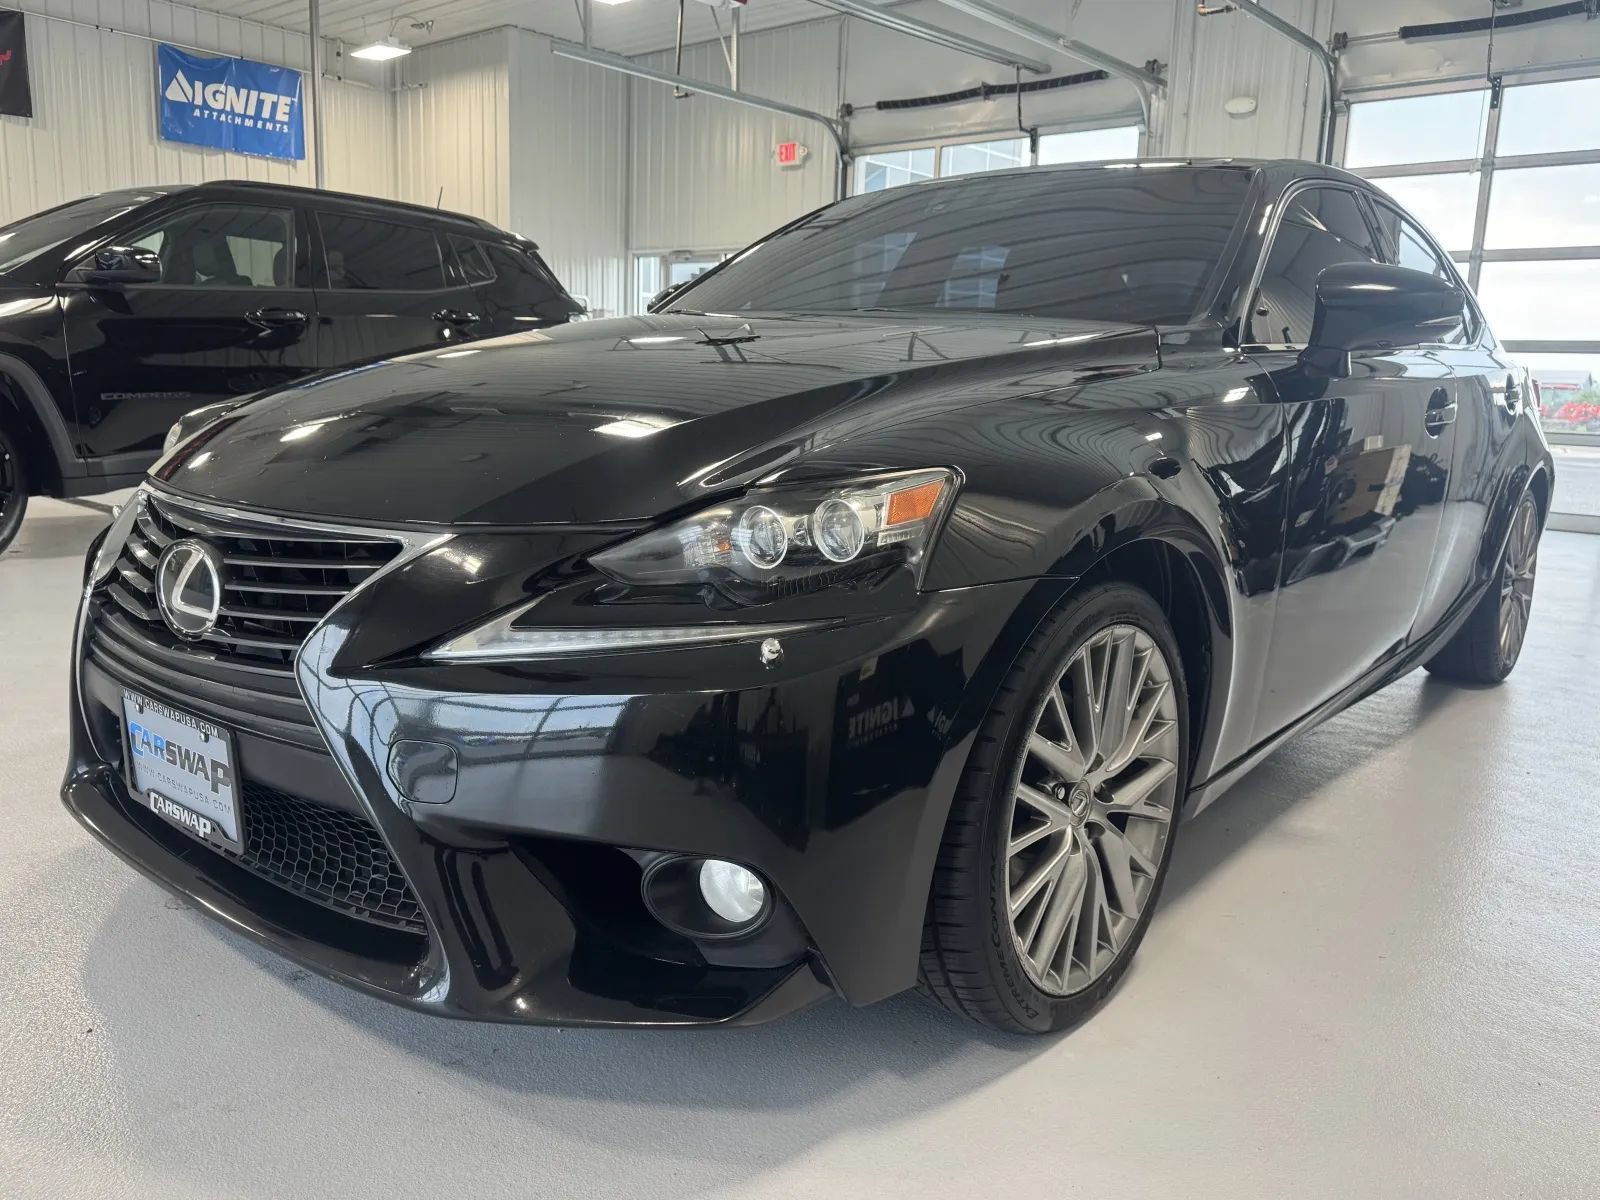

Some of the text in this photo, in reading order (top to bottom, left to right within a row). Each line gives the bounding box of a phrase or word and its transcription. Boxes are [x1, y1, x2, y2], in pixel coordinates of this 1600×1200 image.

[194, 80, 292, 122] IGNITE
[194, 109, 289, 133] ATTACHMENTS
[779, 143, 796, 162] EXIT
[124, 689, 220, 739] WWW.CARSWAPUSA.COM
[129, 720, 232, 794] CARSWAP
[149, 790, 212, 839] CARSWAP
